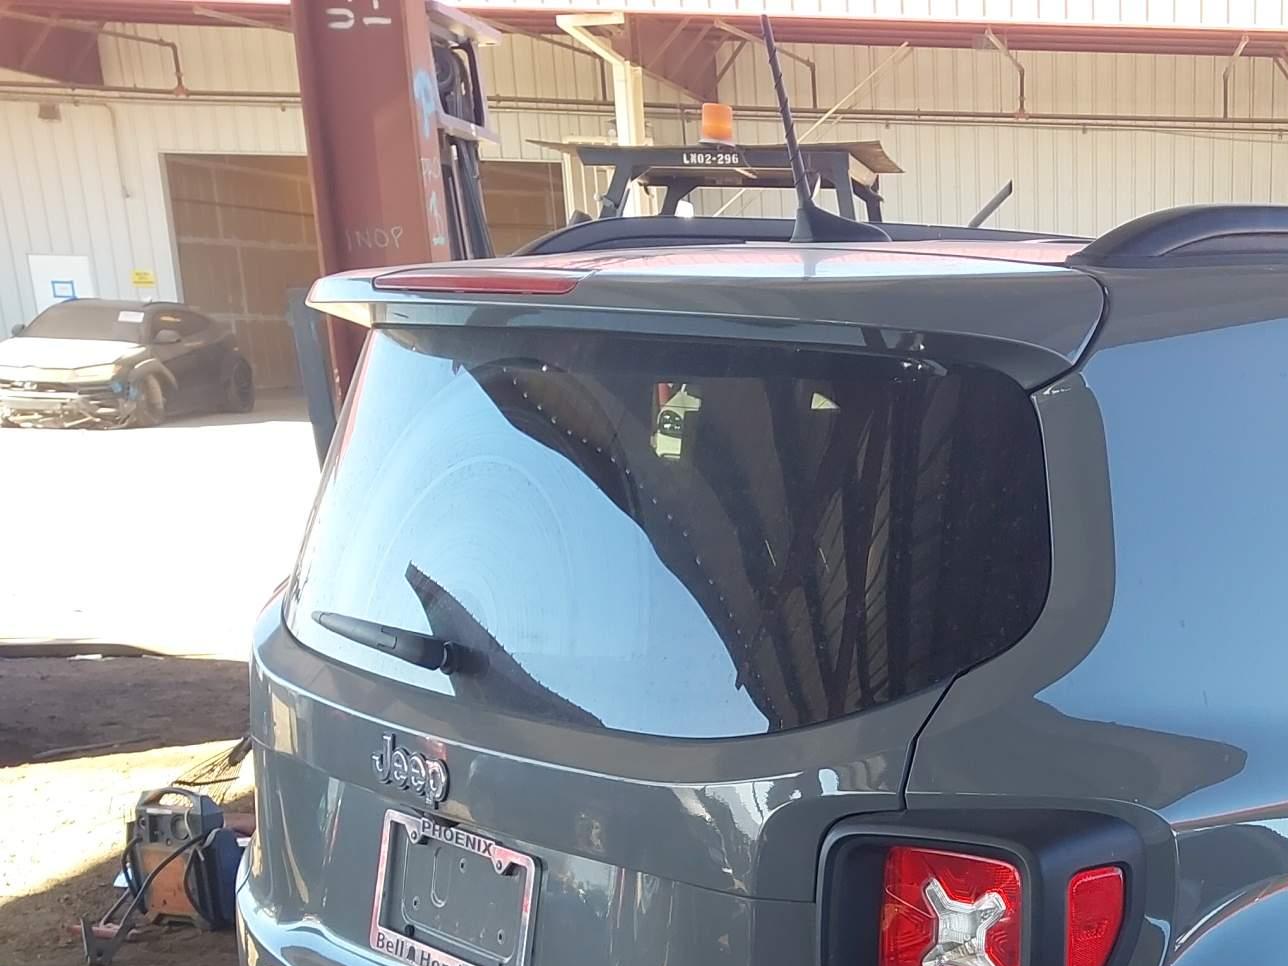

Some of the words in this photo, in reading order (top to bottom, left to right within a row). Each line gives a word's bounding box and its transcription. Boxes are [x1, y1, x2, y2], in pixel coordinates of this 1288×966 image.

[372, 732, 450, 810] Jeep
[421, 819, 493, 857] PHOENIX
[376, 932, 405, 958] Bell
